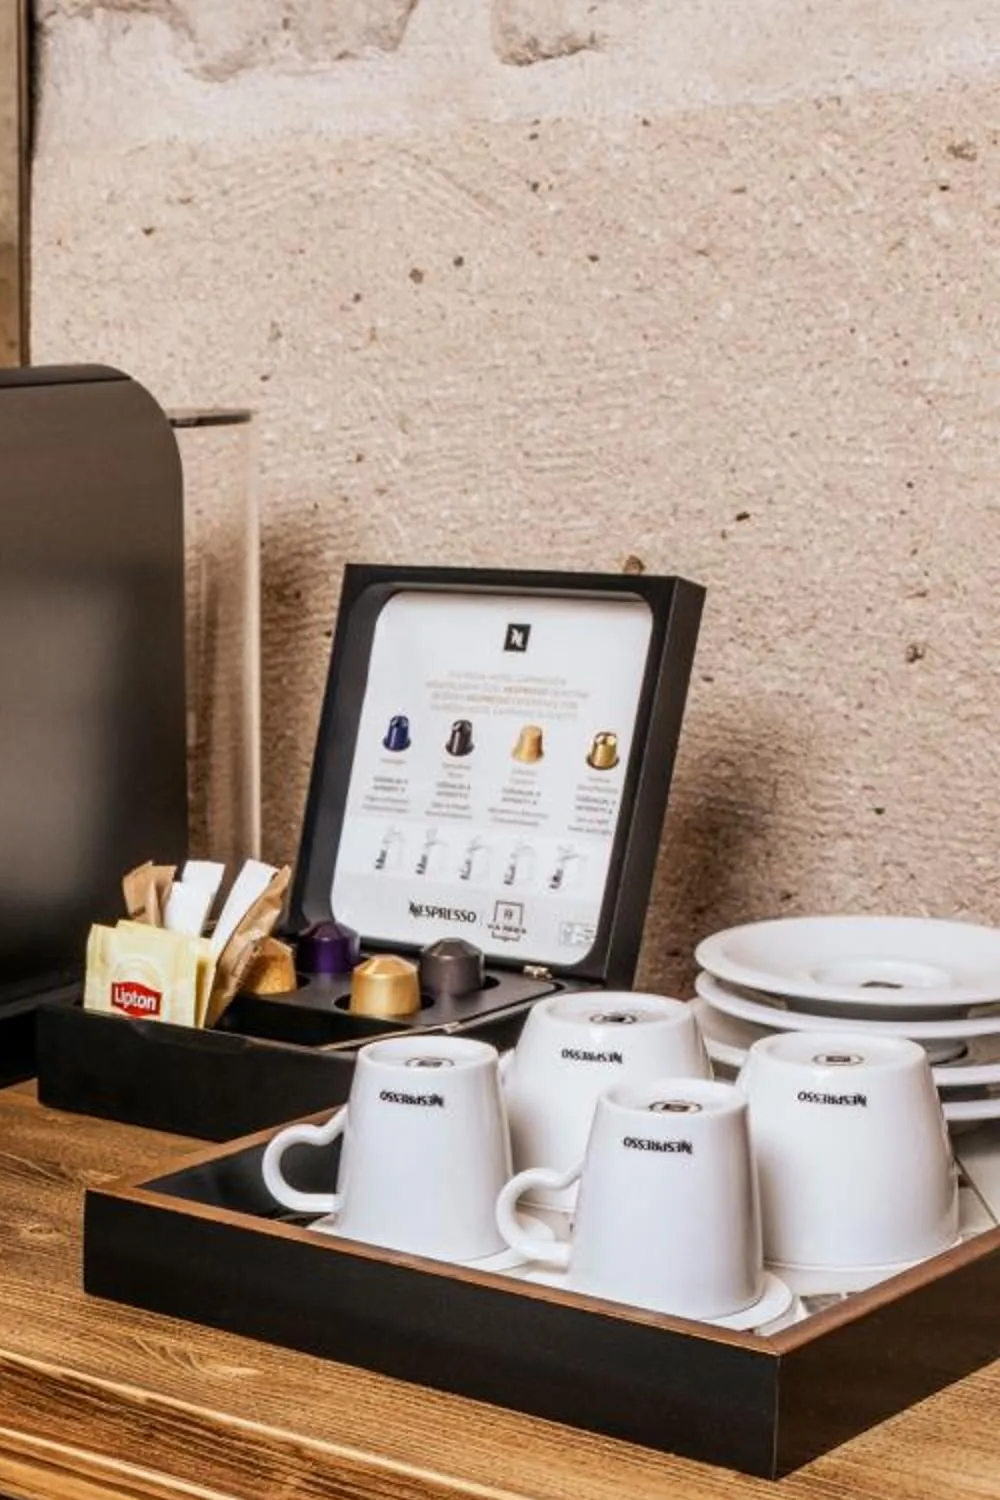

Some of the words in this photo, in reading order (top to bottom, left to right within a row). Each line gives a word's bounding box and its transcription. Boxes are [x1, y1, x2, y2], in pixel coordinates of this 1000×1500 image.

[408, 901, 477, 923] NESPRESSO
[114, 986, 157, 1011] Lipton
[561, 1048, 623, 1064] NESPRESSO
[379, 1090, 444, 1107] NESPRESSO
[797, 1090, 868, 1107] NESPRESSO
[623, 1137, 693, 1154] NESPRESSO
